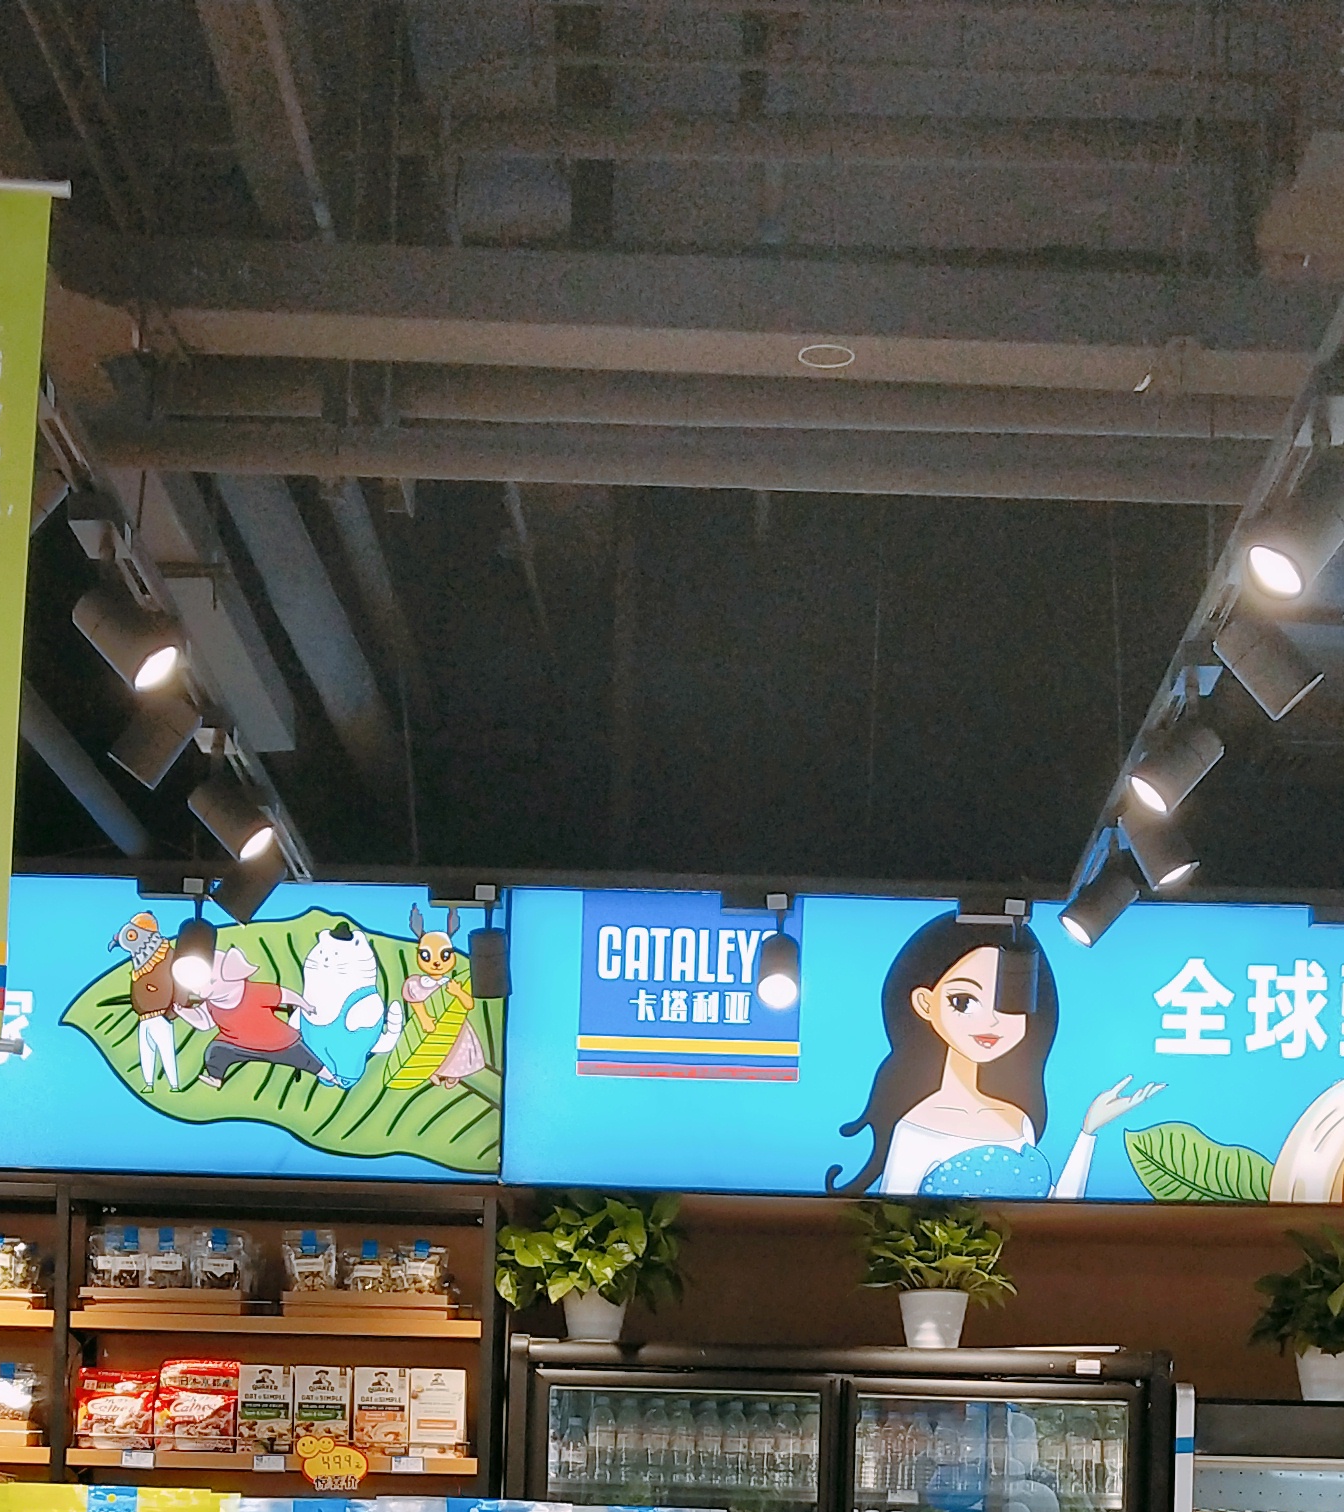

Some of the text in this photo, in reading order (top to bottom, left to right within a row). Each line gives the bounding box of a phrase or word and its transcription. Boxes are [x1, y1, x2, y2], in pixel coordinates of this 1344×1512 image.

[597, 925, 779, 984] CATALEY
[628, 989, 752, 1024] 卡塔利亚
